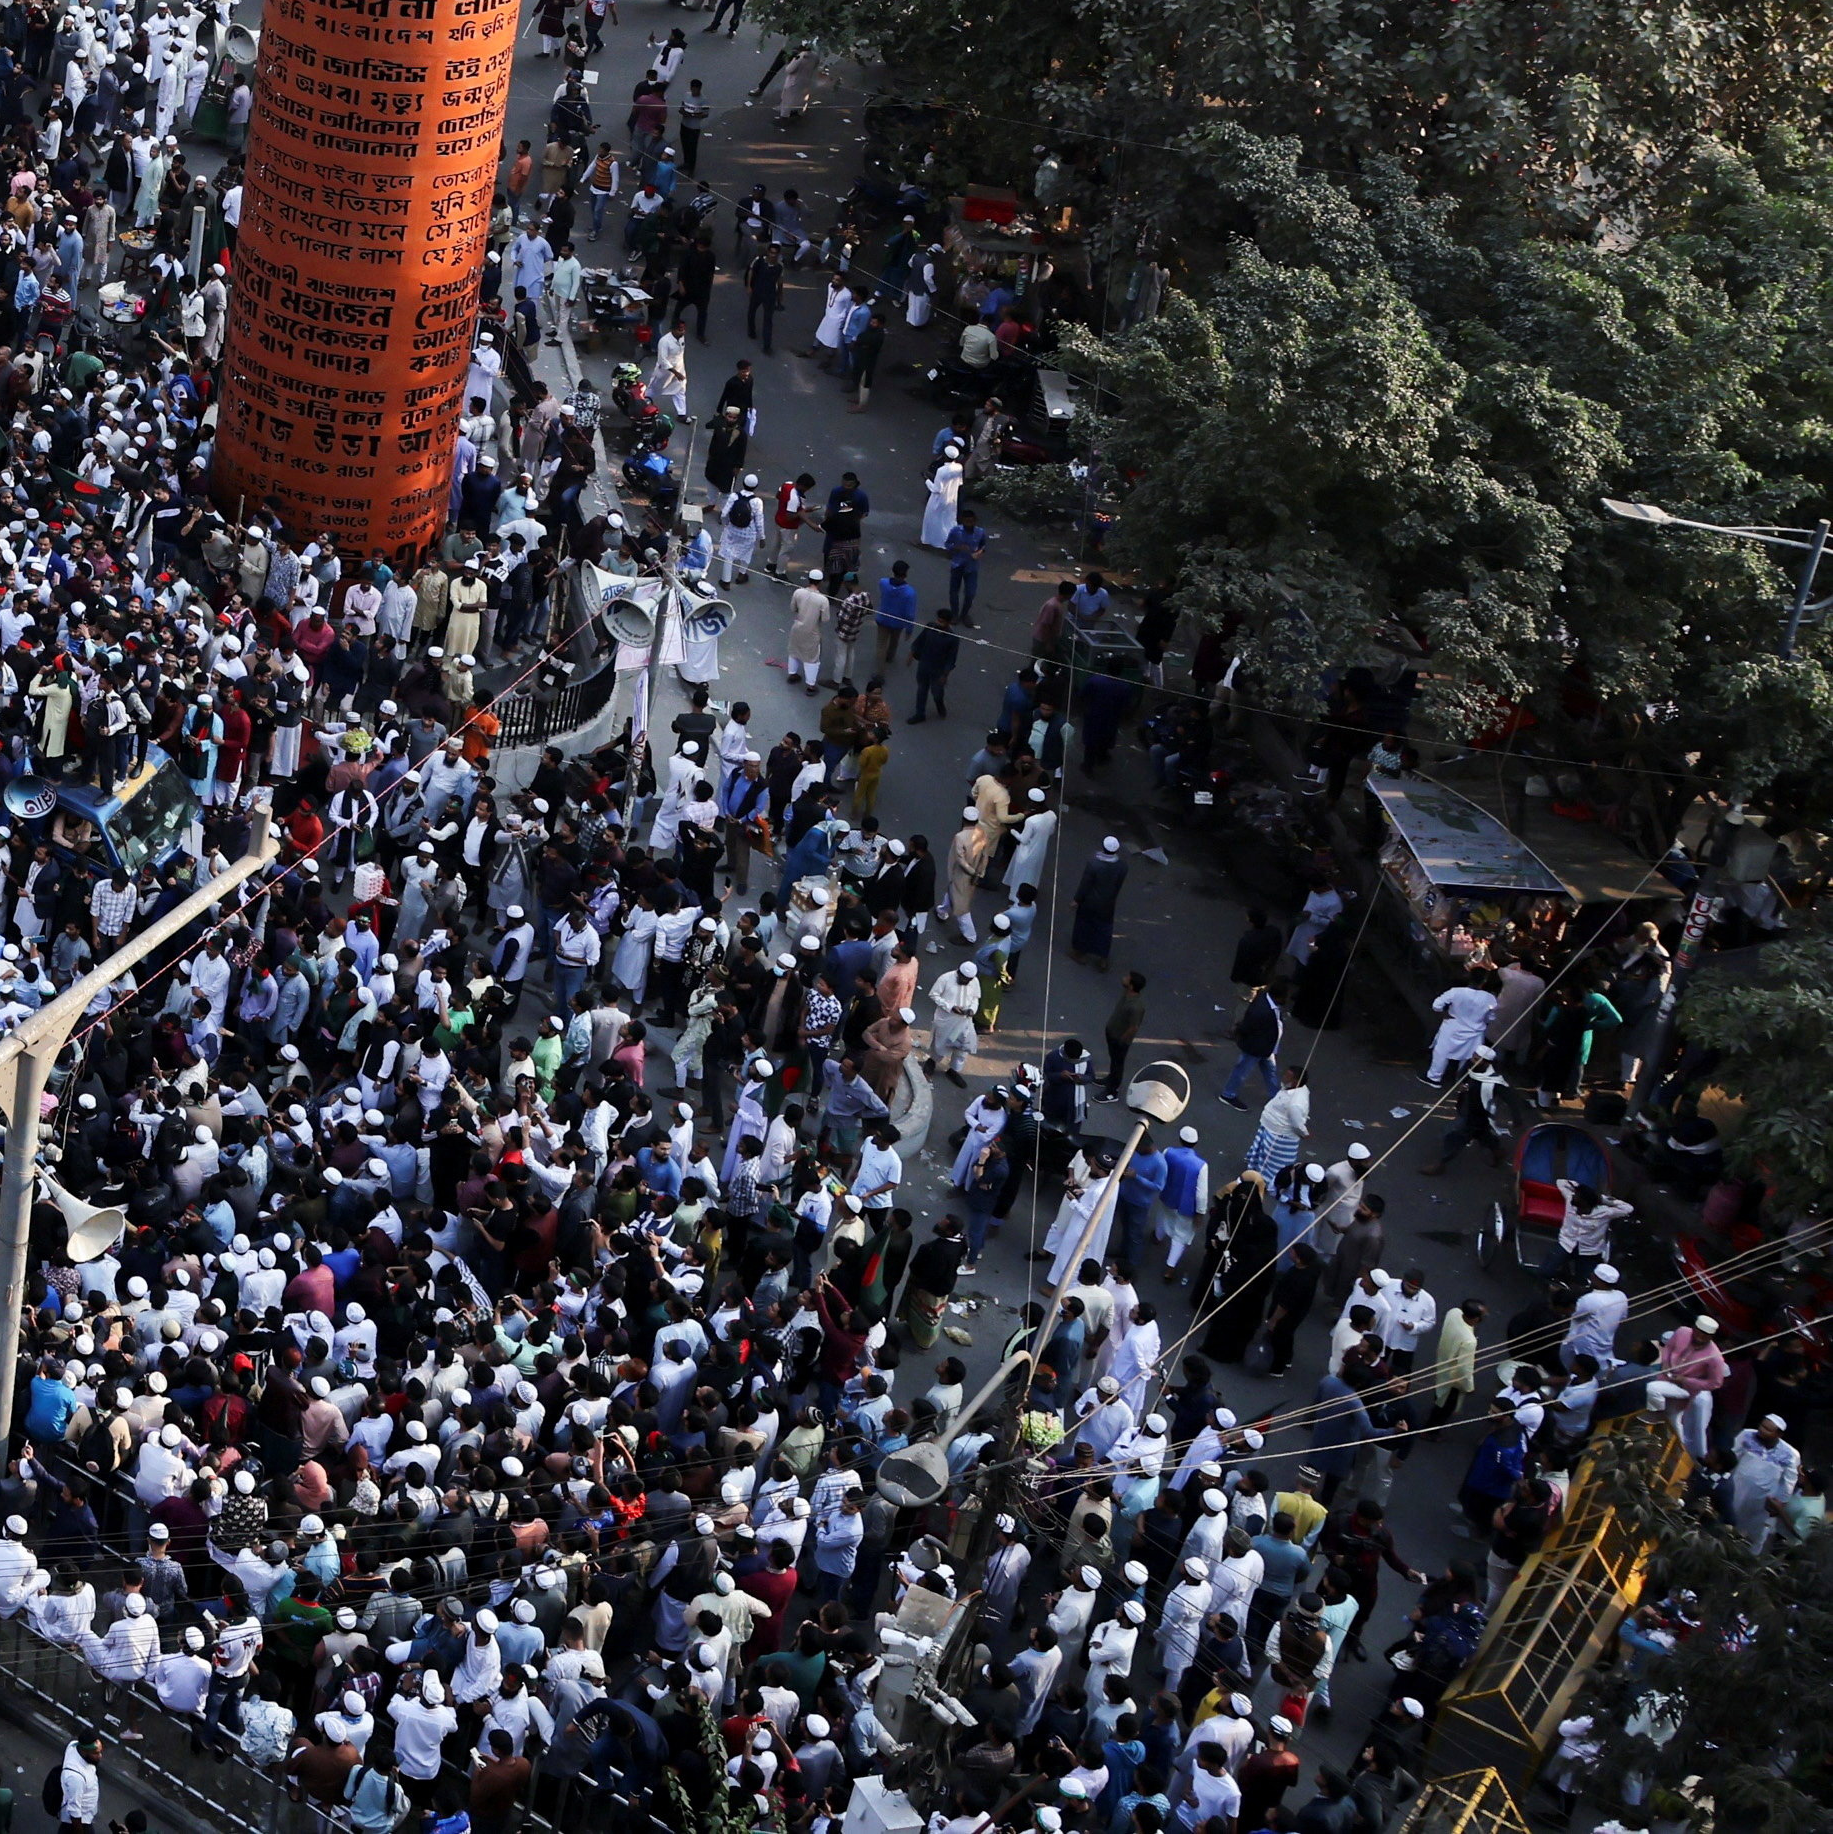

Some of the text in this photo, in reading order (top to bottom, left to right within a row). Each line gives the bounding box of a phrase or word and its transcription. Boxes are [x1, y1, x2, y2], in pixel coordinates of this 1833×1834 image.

[314, 14, 434, 45] বাংলাদেশ
[448, 20, 476, 42] যদি
[322, 54, 428, 83] জাস্টিস
[445, 56, 481, 82] উই
[295, 72, 361, 106] অথবা
[370, 90, 425, 116] মৃত্যু
[319, 109, 422, 140] অধিকার
[312, 132, 420, 162] রাজাকার
[312, 162, 366, 189] যাইবা
[371, 173, 413, 192] ভুলে
[432, 164, 483, 190] তোমরা
[322, 183, 411, 216] ইতিহাস
[430, 190, 464, 221] খুনি
[278, 202, 352, 238] রাখবো
[358, 222, 408, 243] মনে
[426, 221, 454, 243] সে
[279, 227, 405, 266] পোলার লাশ
[422, 247, 447, 266] যে
[305, 275, 396, 302] বাংলাদেশ
[264, 306, 388, 353] অনেকজন
[258, 328, 371, 376] বাপ দাদার
[272, 369, 338, 401] অনেক
[344, 389, 386, 407] ঝড়
[403, 378, 449, 406] বুকের
[285, 395, 337, 425] গুলি
[343, 411, 384, 430] কর
[399, 405, 433, 431] বুক
[290, 454, 329, 475] রক্তে
[395, 462, 422, 477] কত
[271, 473, 327, 507] শিকল
